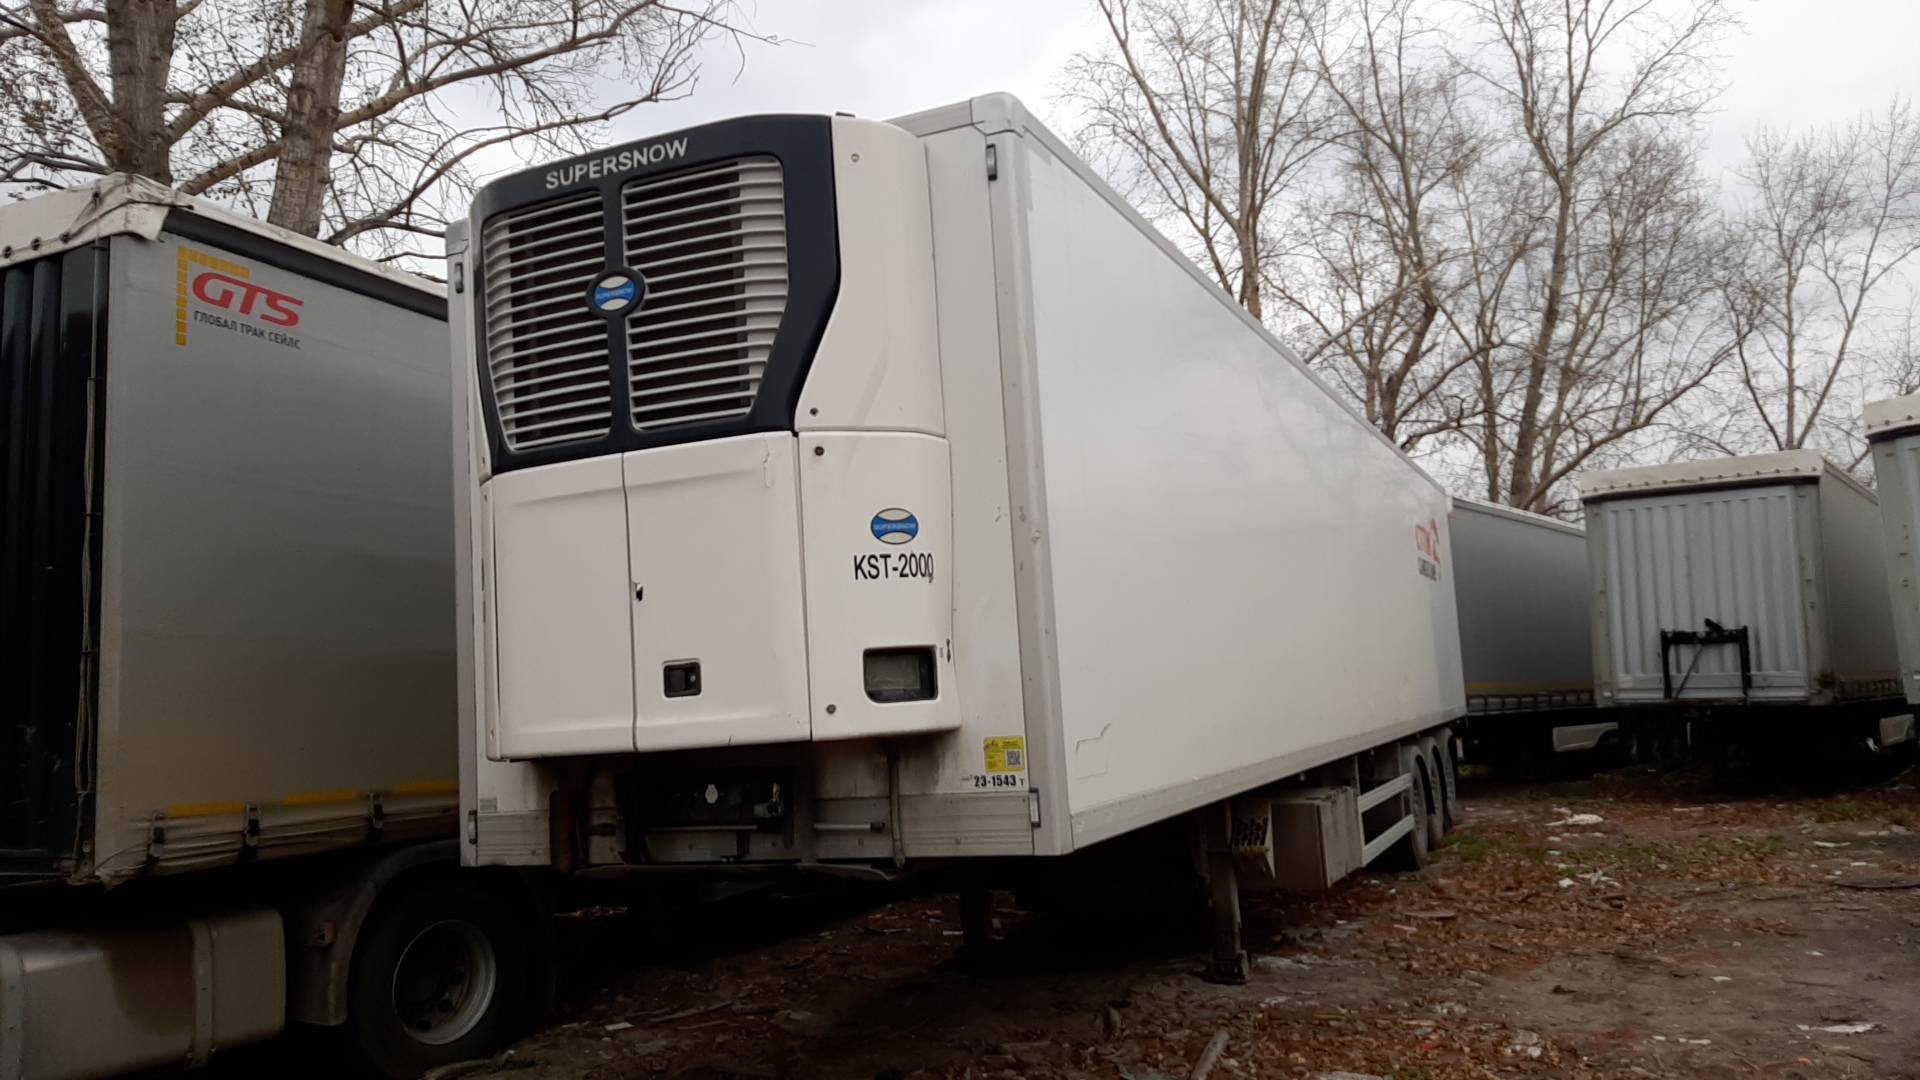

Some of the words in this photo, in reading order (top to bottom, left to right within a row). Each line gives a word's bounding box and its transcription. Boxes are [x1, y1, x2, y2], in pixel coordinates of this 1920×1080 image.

[545, 137, 688, 189] SUPERSNOW
[192, 271, 305, 327] GTS
[193, 310, 238, 331] ГЛОБАЛ
[239, 322, 266, 340] ТРАК
[267, 331, 301, 350] СЕЙЛС
[853, 552, 934, 581] KST-2000
[974, 774, 1017, 787] 23-1543
